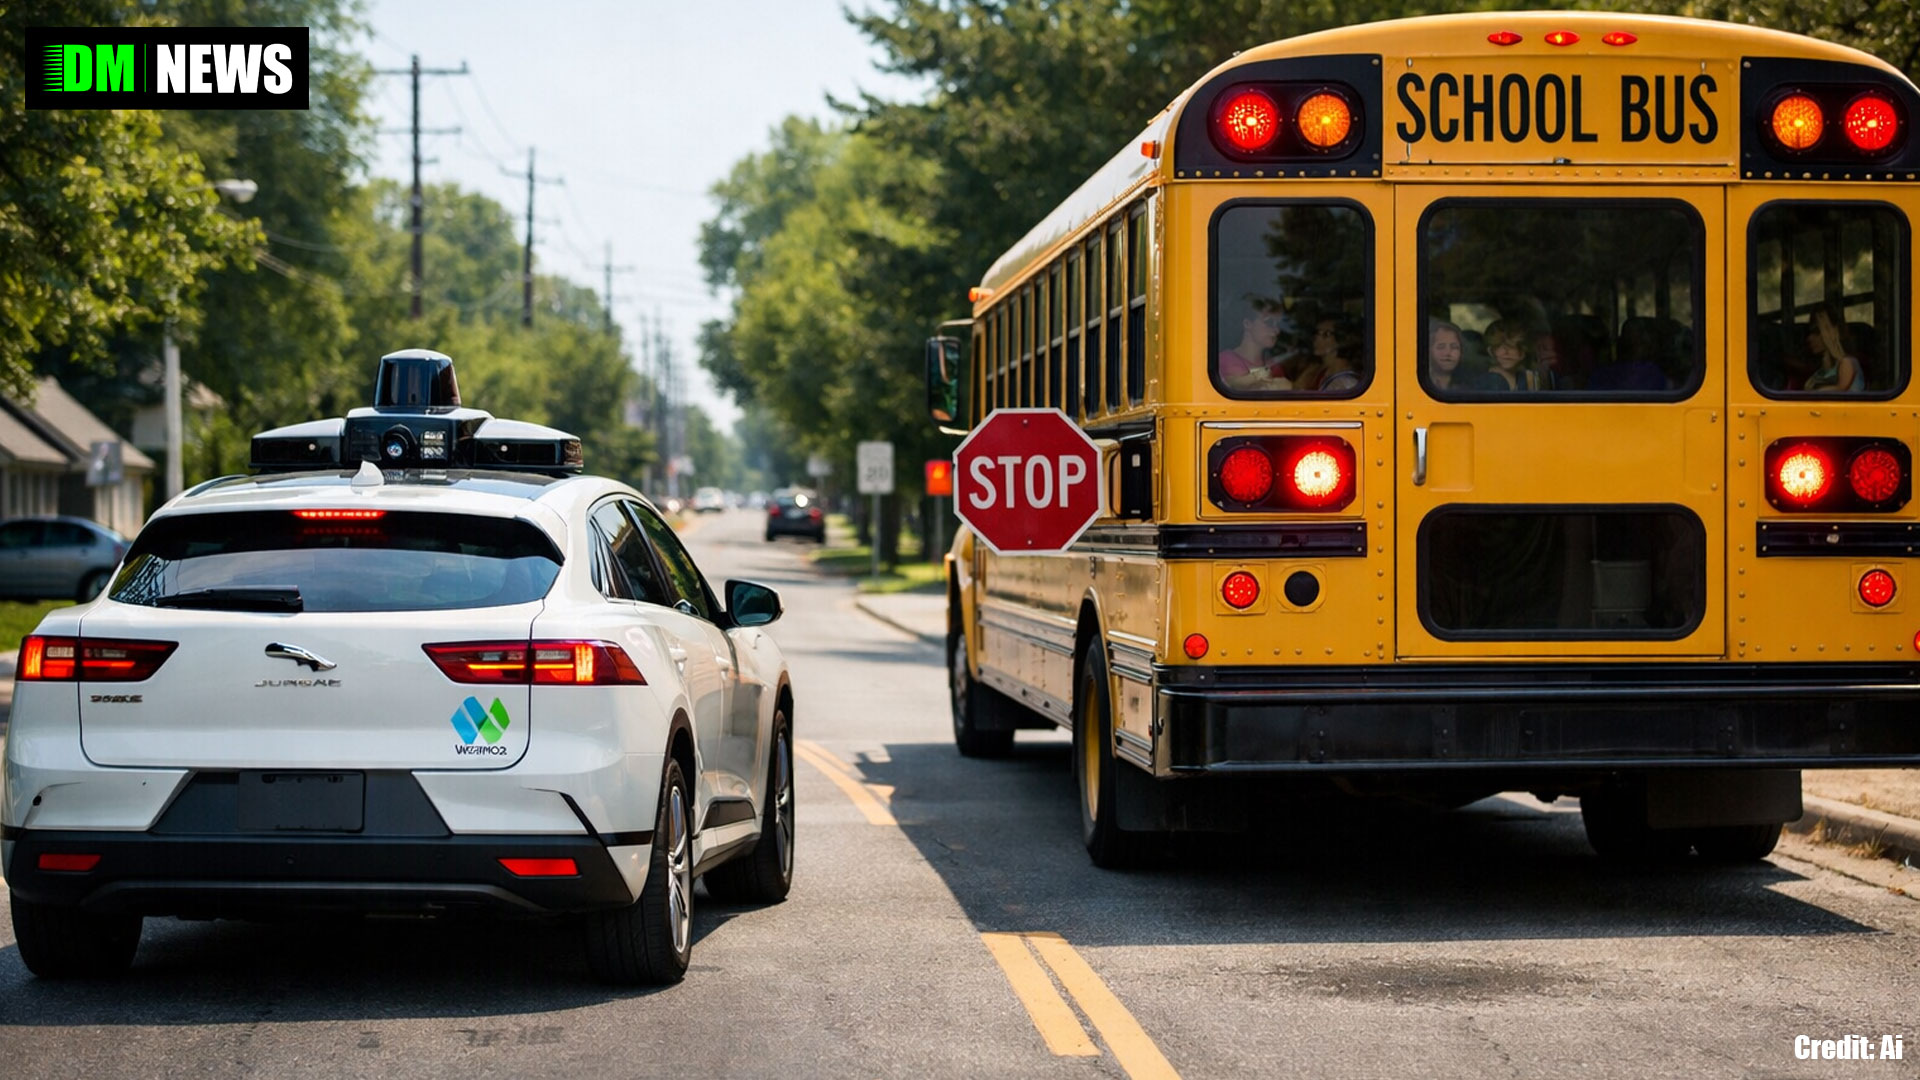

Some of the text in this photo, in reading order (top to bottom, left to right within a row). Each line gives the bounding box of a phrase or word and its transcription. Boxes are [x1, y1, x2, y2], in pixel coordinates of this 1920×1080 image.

[1396, 72, 1718, 144] SCHOOL BUS
[969, 454, 1087, 510] STOP
